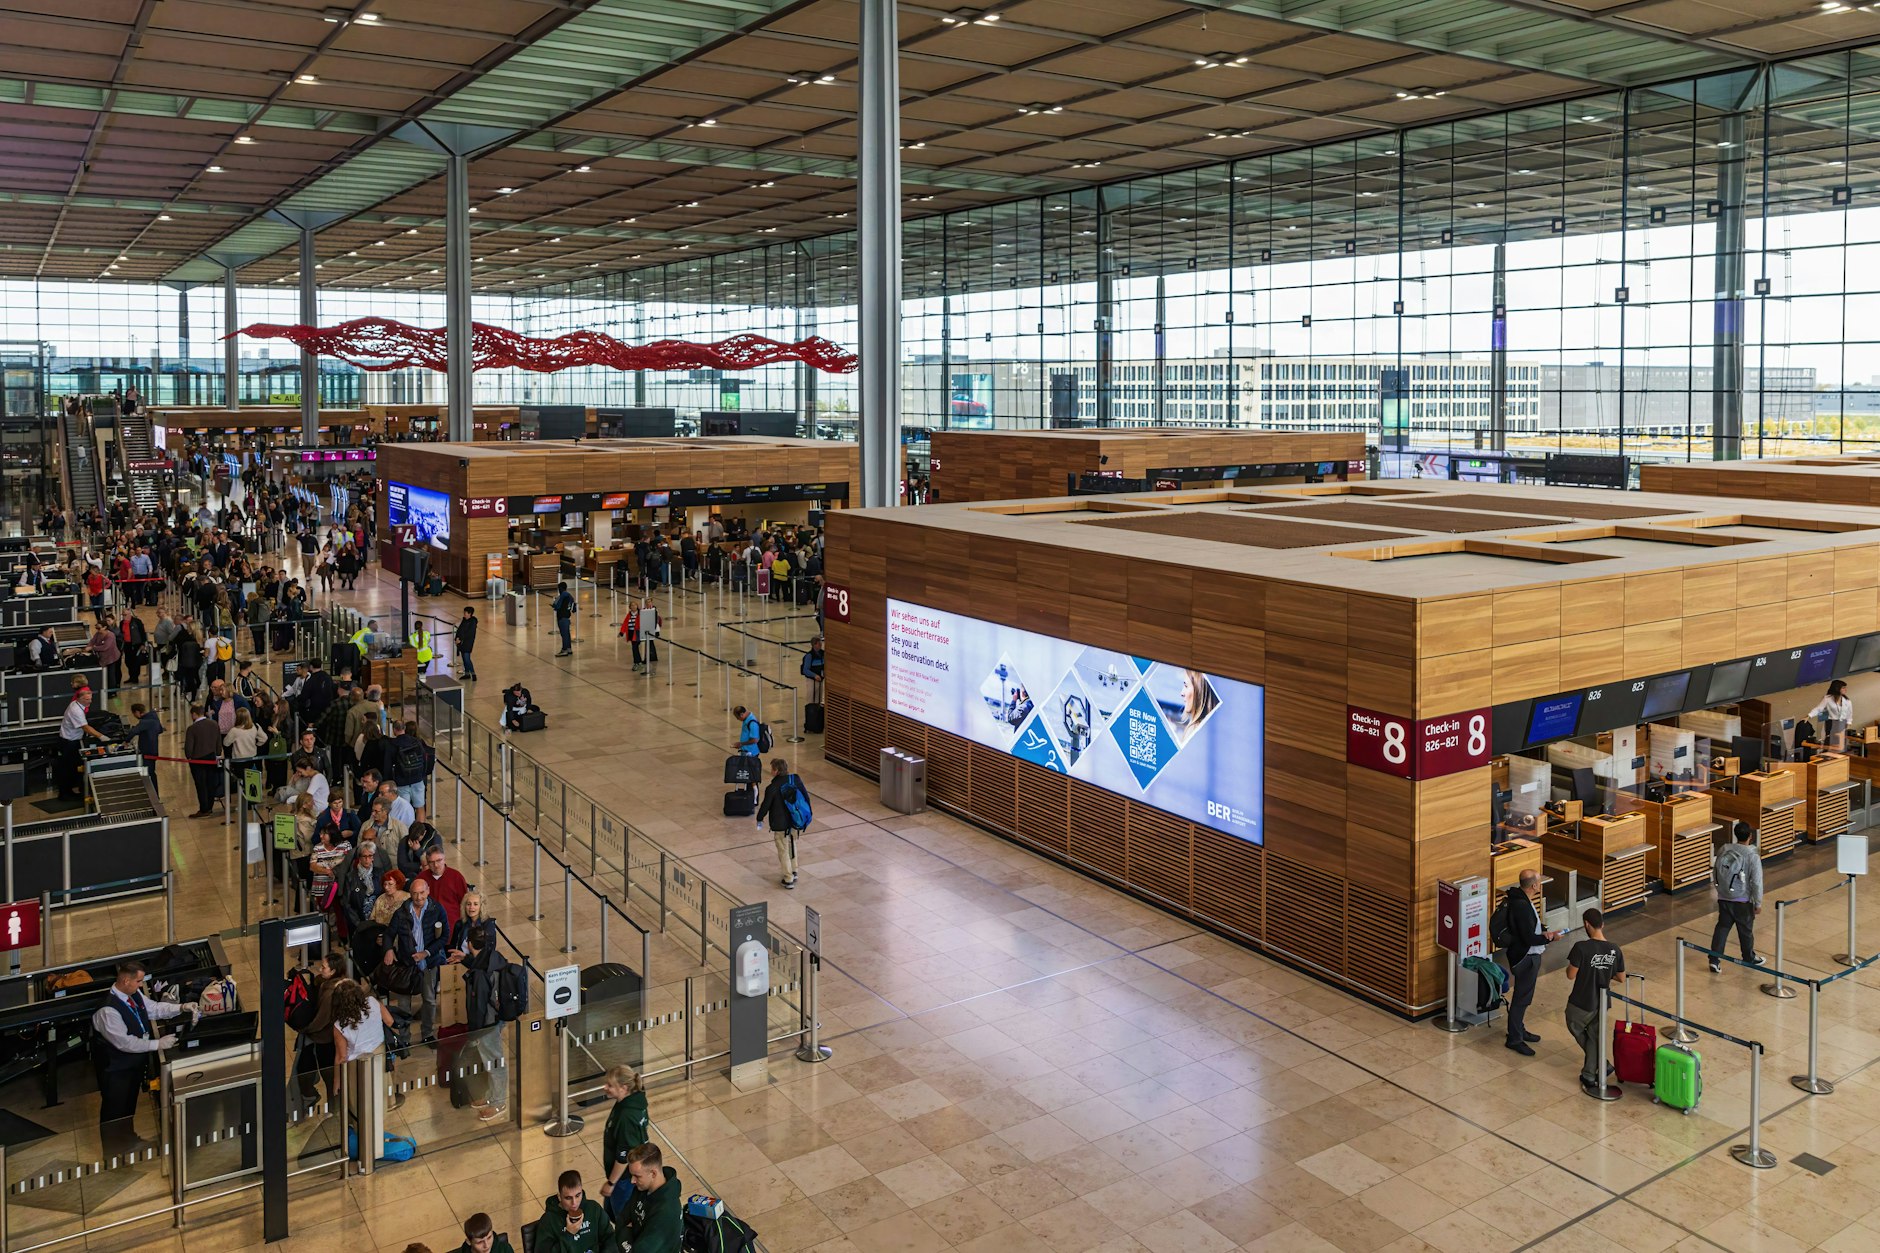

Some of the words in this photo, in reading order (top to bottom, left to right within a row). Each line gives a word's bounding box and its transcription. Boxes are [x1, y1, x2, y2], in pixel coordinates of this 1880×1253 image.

[1012, 360, 1028, 374] P8
[936, 460, 941, 470] 5
[1360, 461, 1364, 471] 5
[494, 498, 505, 514] 6
[403, 528, 416, 545] 4
[839, 590, 848, 616] 8
[891, 608, 901, 618] Wir
[902, 612, 918, 623] sehen
[919, 617, 929, 626] uns
[930, 619, 940, 629] auf
[891, 622, 900, 631] der
[901, 625, 949, 645] Besucherterrasse
[891, 634, 901, 644] See
[902, 639, 912, 648] you
[913, 641, 919, 649] at
[891, 647, 901, 656] the
[901, 650, 934, 668] observation
[936, 661, 949, 671] deck
[1756, 657, 1767, 667] 824
[1791, 650, 1802, 660] 823
[1632, 681, 1645, 692] 825
[1588, 690, 1602, 700] 826
[1130, 708, 1141, 718] BER
[1142, 712, 1156, 723] Now
[1352, 713, 1380, 726] Check-in
[1352, 724, 1380, 736] 826–821
[1425, 720, 1460, 736] Check-in
[1468, 715, 1486, 756] 8
[1383, 721, 1406, 764] 8
[1425, 736, 1459, 752] 826–821
[1208, 800, 1230, 821] BER
[204, 1003, 224, 1012] UCL
